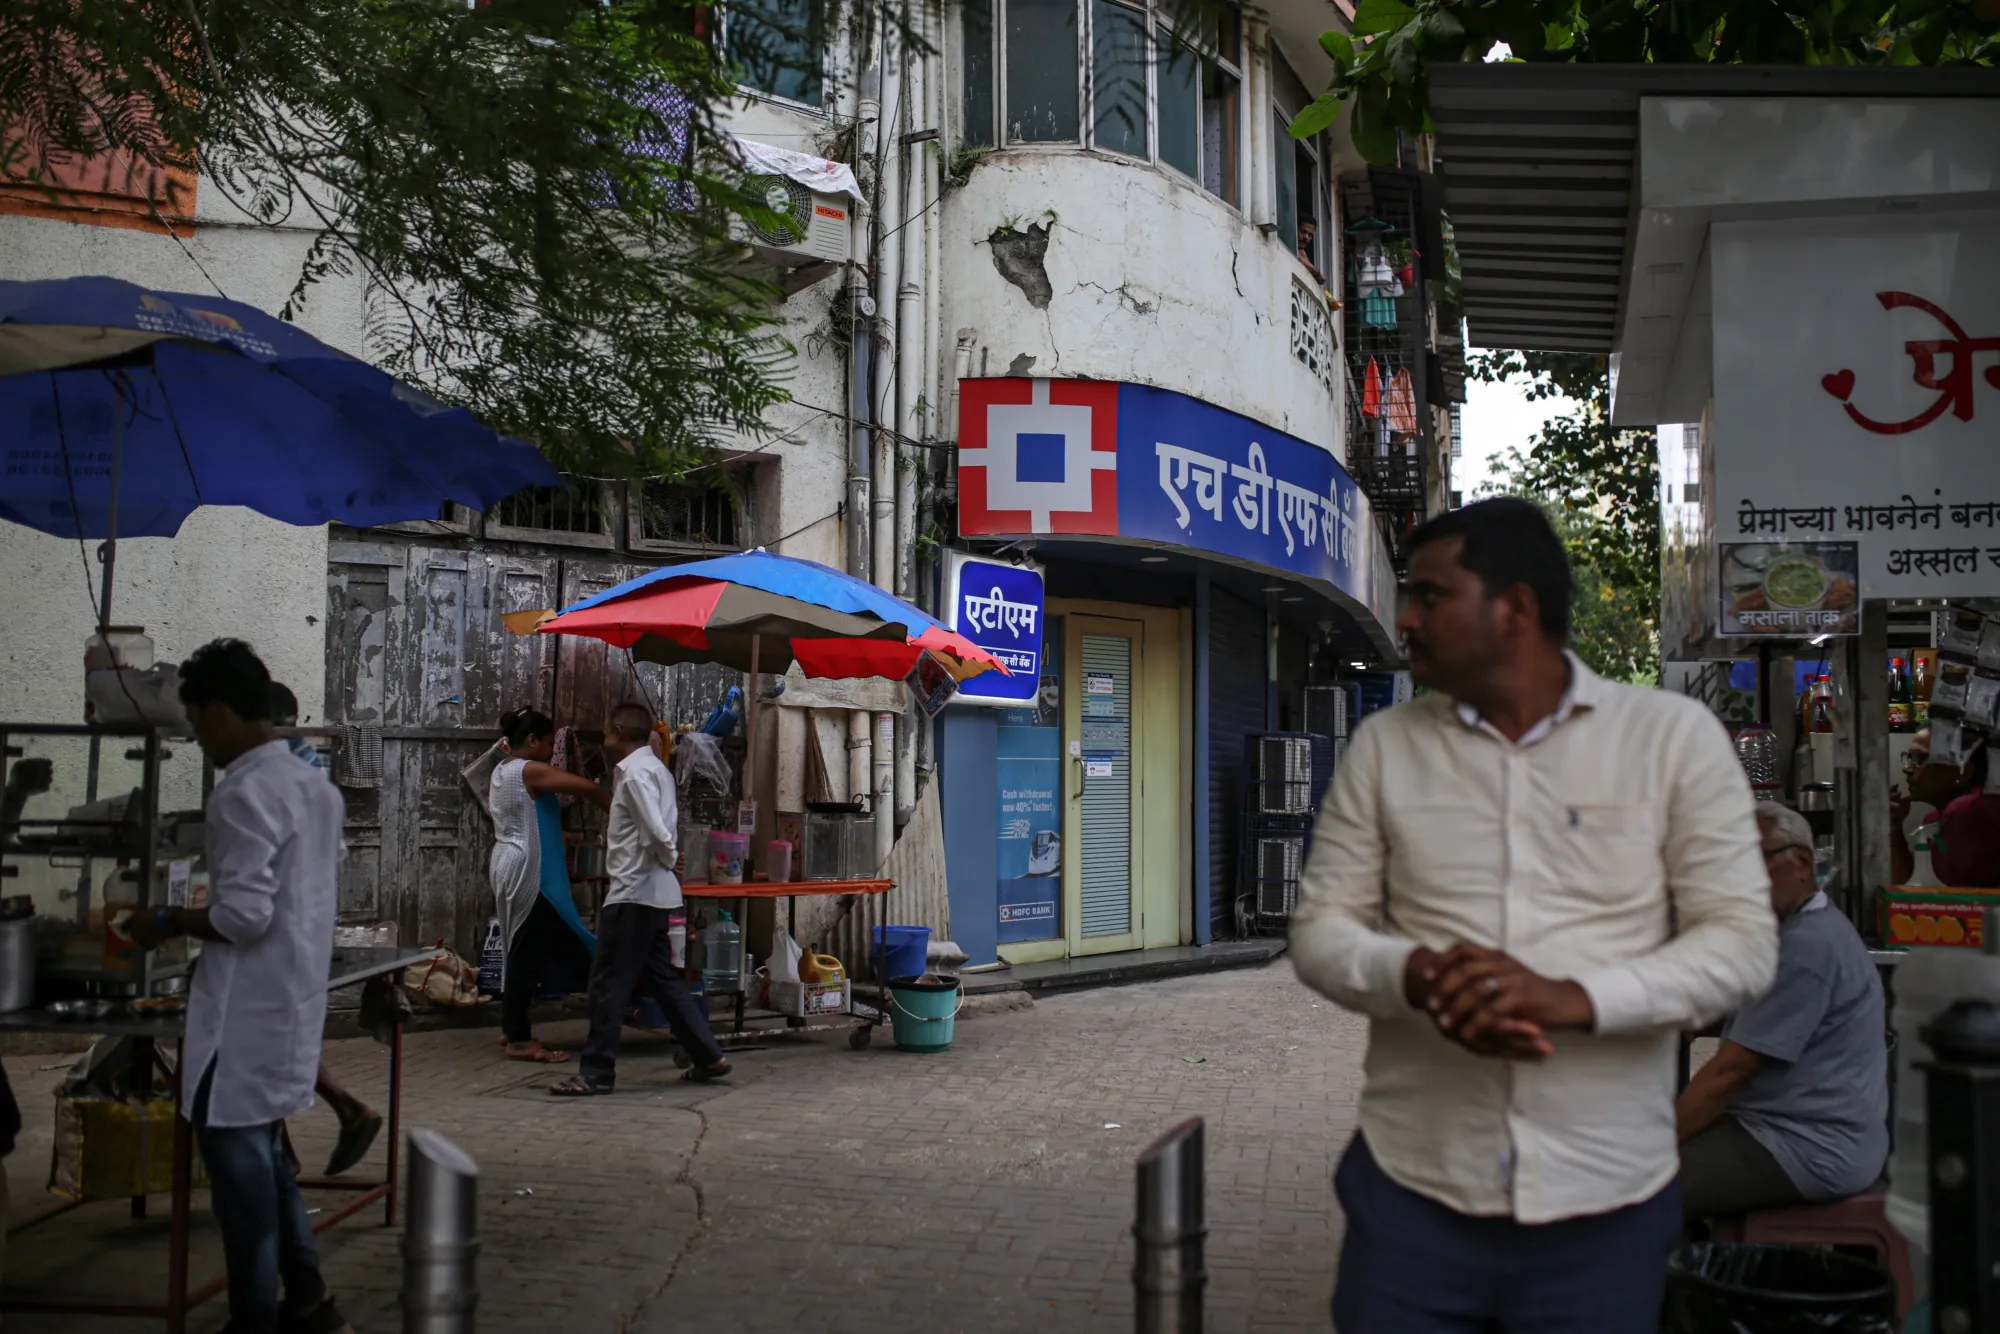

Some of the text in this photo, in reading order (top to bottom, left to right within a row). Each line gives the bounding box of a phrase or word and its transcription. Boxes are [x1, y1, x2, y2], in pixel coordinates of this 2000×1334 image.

[817, 207, 843, 219] HITACHI
[1156, 442, 1227, 530] एच
[1231, 441, 1273, 535] डी
[1276, 478, 1319, 557] एफ
[1320, 477, 1340, 560] सी
[1737, 499, 1837, 534] प्रेमाच्या
[1844, 488, 1943, 531] भावनेनं
[1887, 546, 1980, 576] अस्सल
[964, 586, 1038, 639] एटीएम
[1738, 609, 1799, 627] मसाला
[1007, 713, 1024, 723] Here
[1002, 789, 1053, 799] Cash withdrawal
[1032, 803, 1053, 812] faster!
[1012, 905, 1051, 917] HDFC BANK
